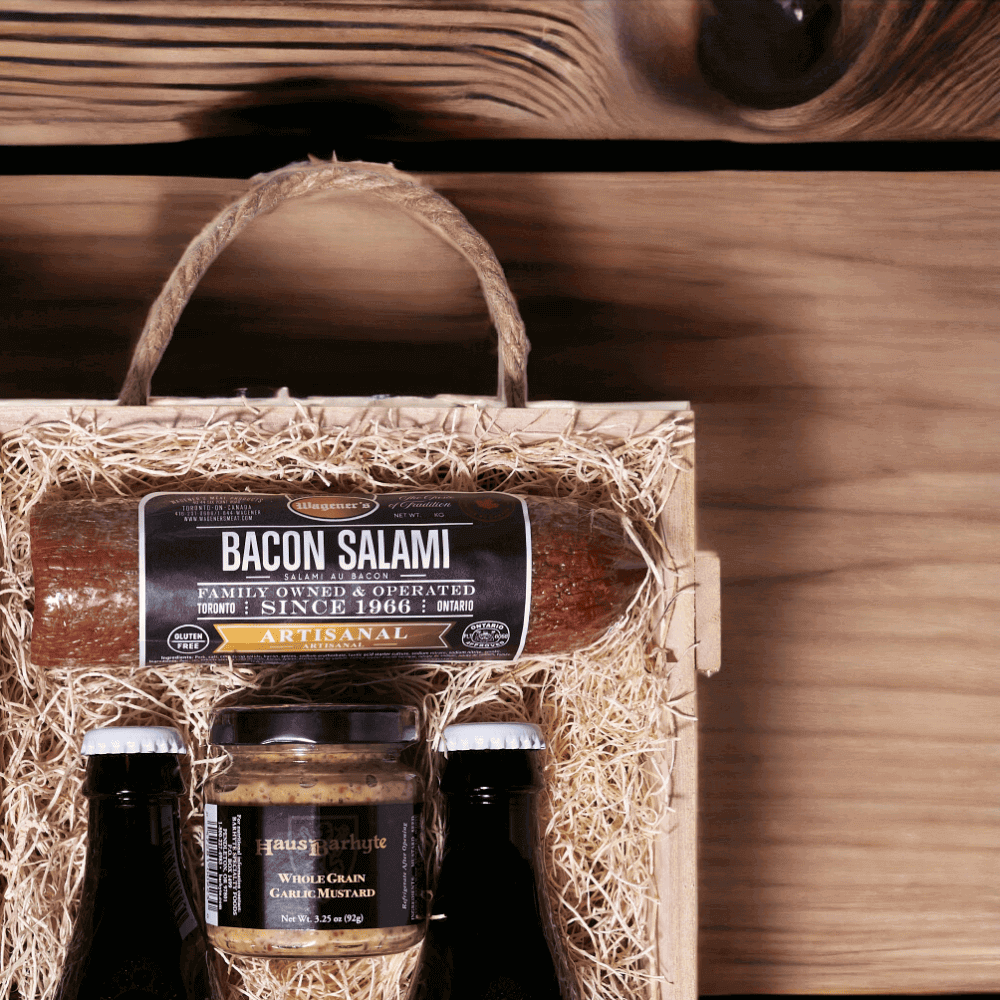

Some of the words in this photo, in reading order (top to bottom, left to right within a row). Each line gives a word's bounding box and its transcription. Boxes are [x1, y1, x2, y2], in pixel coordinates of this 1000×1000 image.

[296, 502, 371, 511] Wagener's
[400, 501, 452, 509] Tradition
[222, 530, 325, 572] BACON
[338, 529, 450, 570] SALAMI
[198, 586, 268, 599] FAMILY
[276, 586, 346, 598] OWNED
[352, 586, 366, 597] &
[372, 584, 476, 597] OPERATED
[197, 602, 236, 615] TORONTO
[261, 600, 346, 615] SINCE
[355, 599, 411, 615] 1966
[437, 600, 474, 612] ONTARIO
[260, 627, 408, 643] ARTISANAL
[255, 839, 307, 856] Haus
[278, 873, 326, 884] WHOLE
[327, 873, 366, 884] GRAIN
[270, 888, 315, 898] GARLIC
[317, 888, 376, 898] MUSTARD
[281, 915, 295, 923] Net
[297, 915, 312, 923] Wt.
[314, 915, 331, 923] 3.25
[344, 914, 364, 924] (92g)
